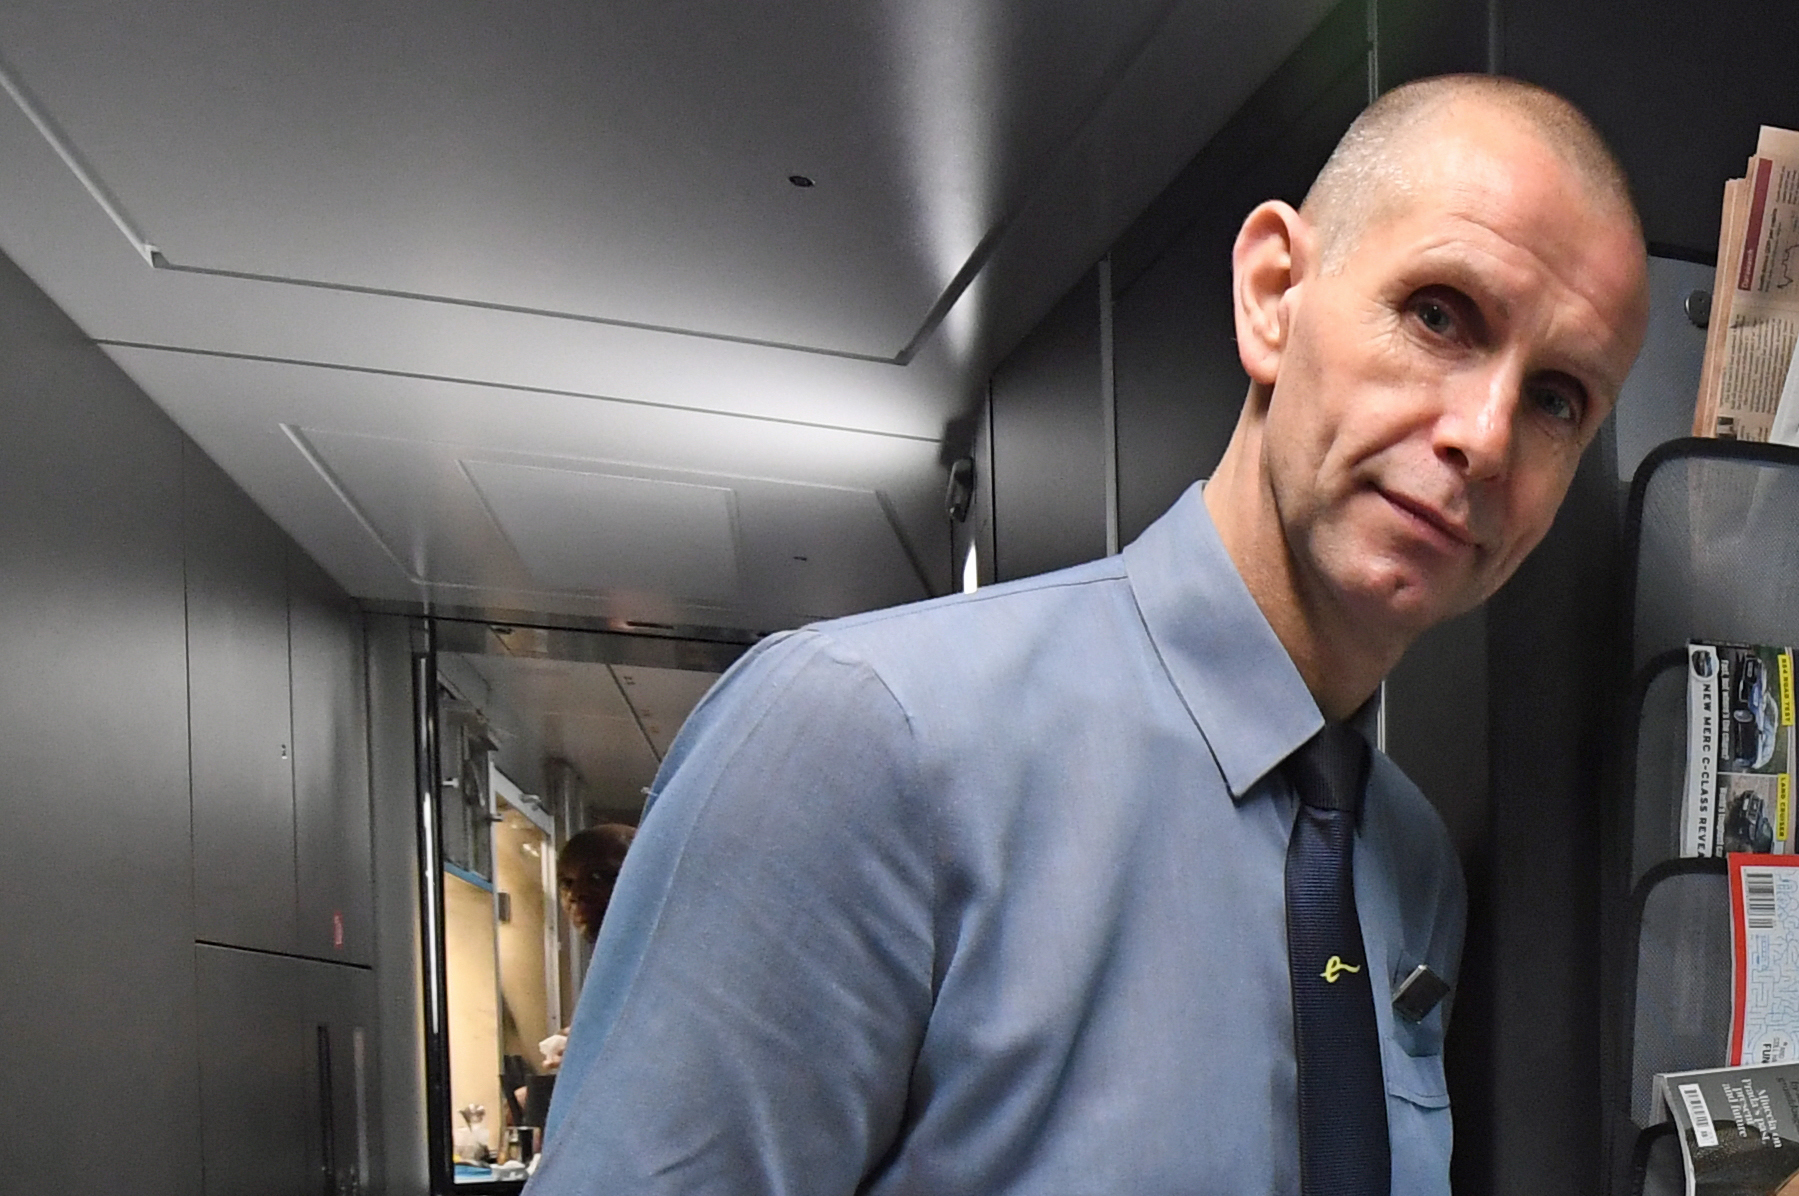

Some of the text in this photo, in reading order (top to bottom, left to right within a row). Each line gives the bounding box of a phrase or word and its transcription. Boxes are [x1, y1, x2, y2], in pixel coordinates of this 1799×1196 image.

[1699, 684, 1711, 812] NEW MERC C-CLASS
[1722, 1083, 1748, 1138] and future
[1732, 1087, 1755, 1125] present
[1757, 1089, 1783, 1148] Miuccia on
